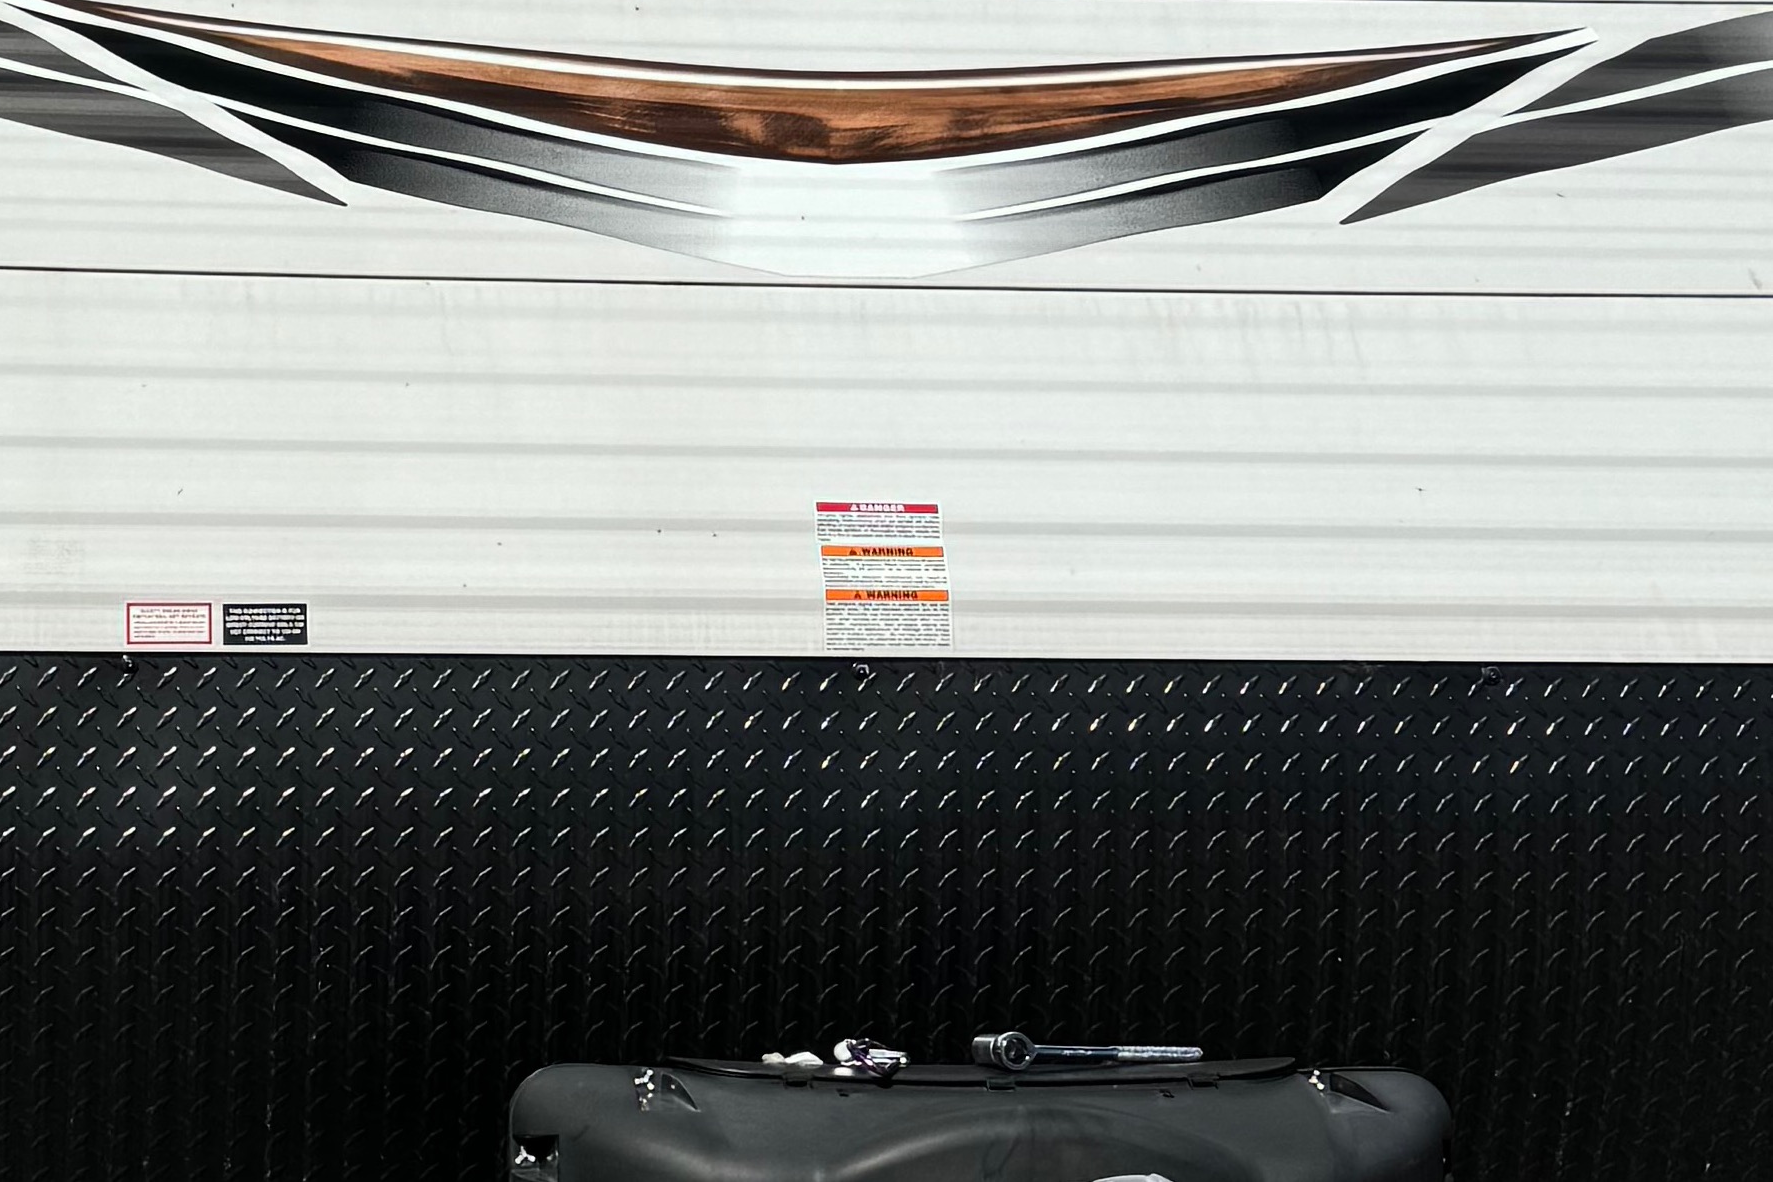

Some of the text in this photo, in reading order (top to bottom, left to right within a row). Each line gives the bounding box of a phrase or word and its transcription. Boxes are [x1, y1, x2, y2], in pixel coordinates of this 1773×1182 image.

[860, 503, 906, 512] DANGER
[861, 547, 914, 556] WARNING
[867, 590, 918, 600] WARNING
